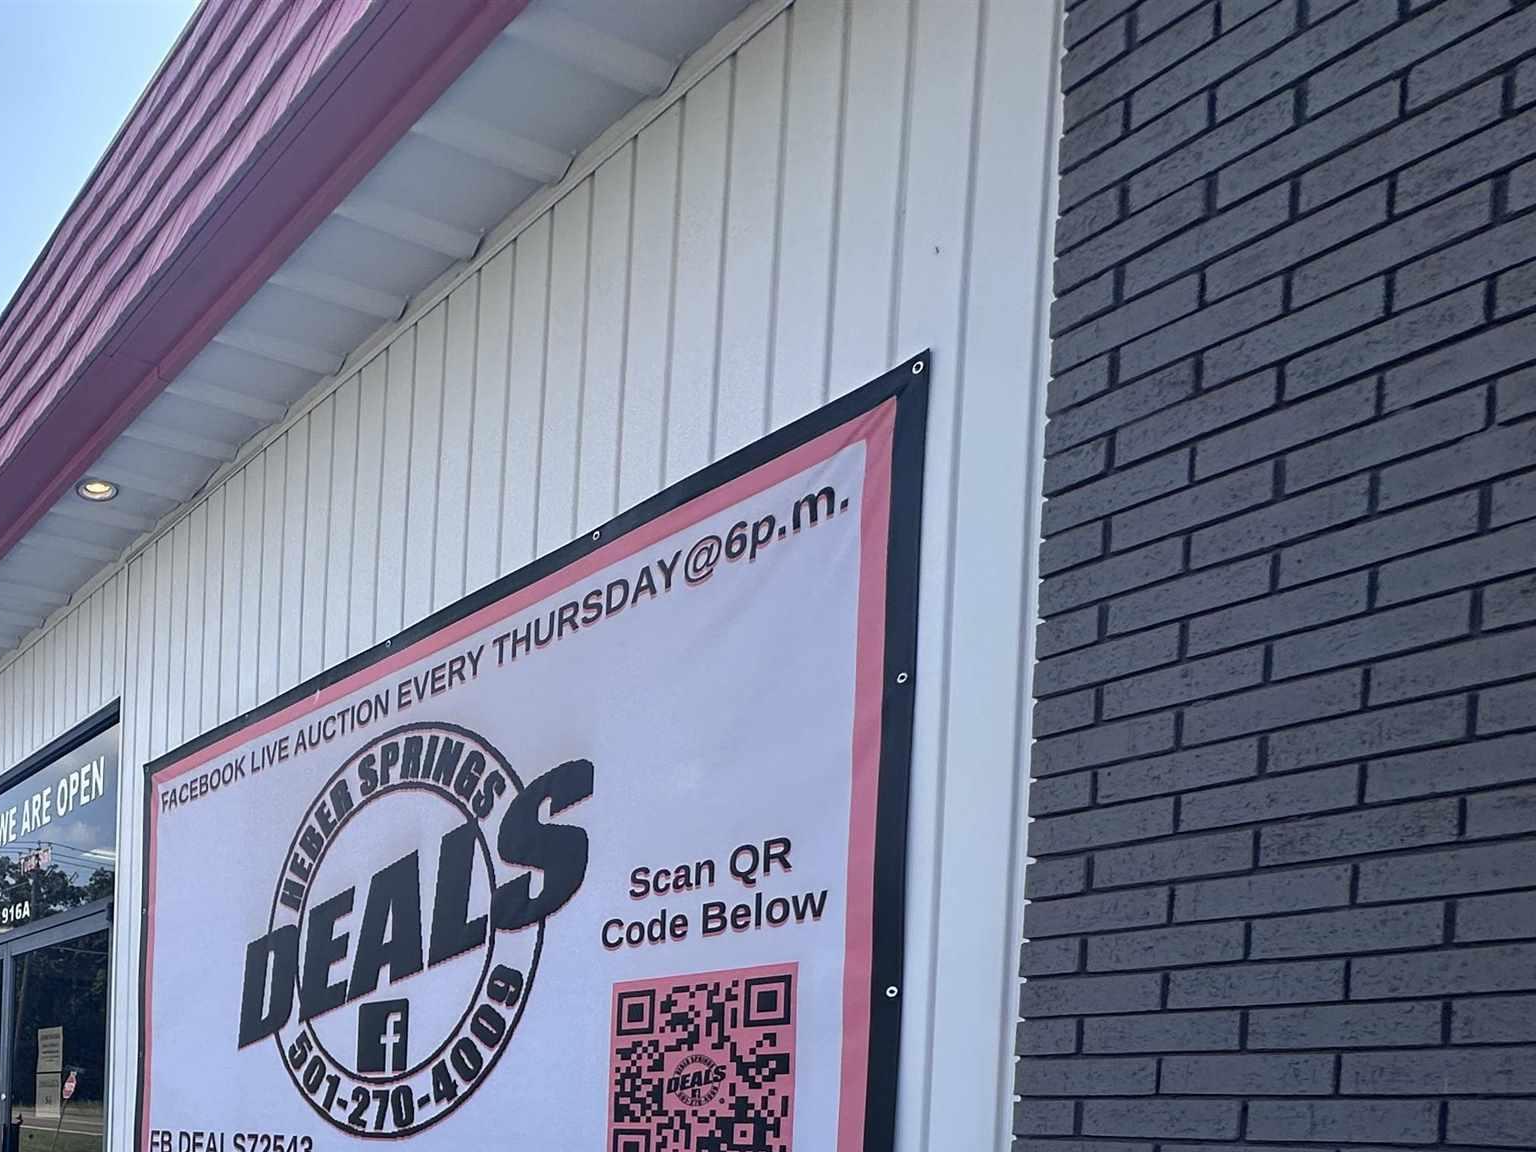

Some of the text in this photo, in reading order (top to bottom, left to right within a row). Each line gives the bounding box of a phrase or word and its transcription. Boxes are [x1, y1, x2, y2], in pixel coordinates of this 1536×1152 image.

[160, 484, 850, 813] FACEBOOK LIVE AUCTION EVERY THURSDAY@6p.m.
[20, 786, 52, 837] ARE
[56, 755, 105, 817] OPEN
[279, 734, 507, 912] HEBER SPRINGS
[238, 758, 595, 1050] DEALS
[629, 836, 793, 899] Scan QR
[1, 900, 31, 924] 916A
[601, 889, 829, 950] Code Below
[286, 964, 524, 1132] 501-270-4009
[666, 1064, 727, 1095] DEALS
